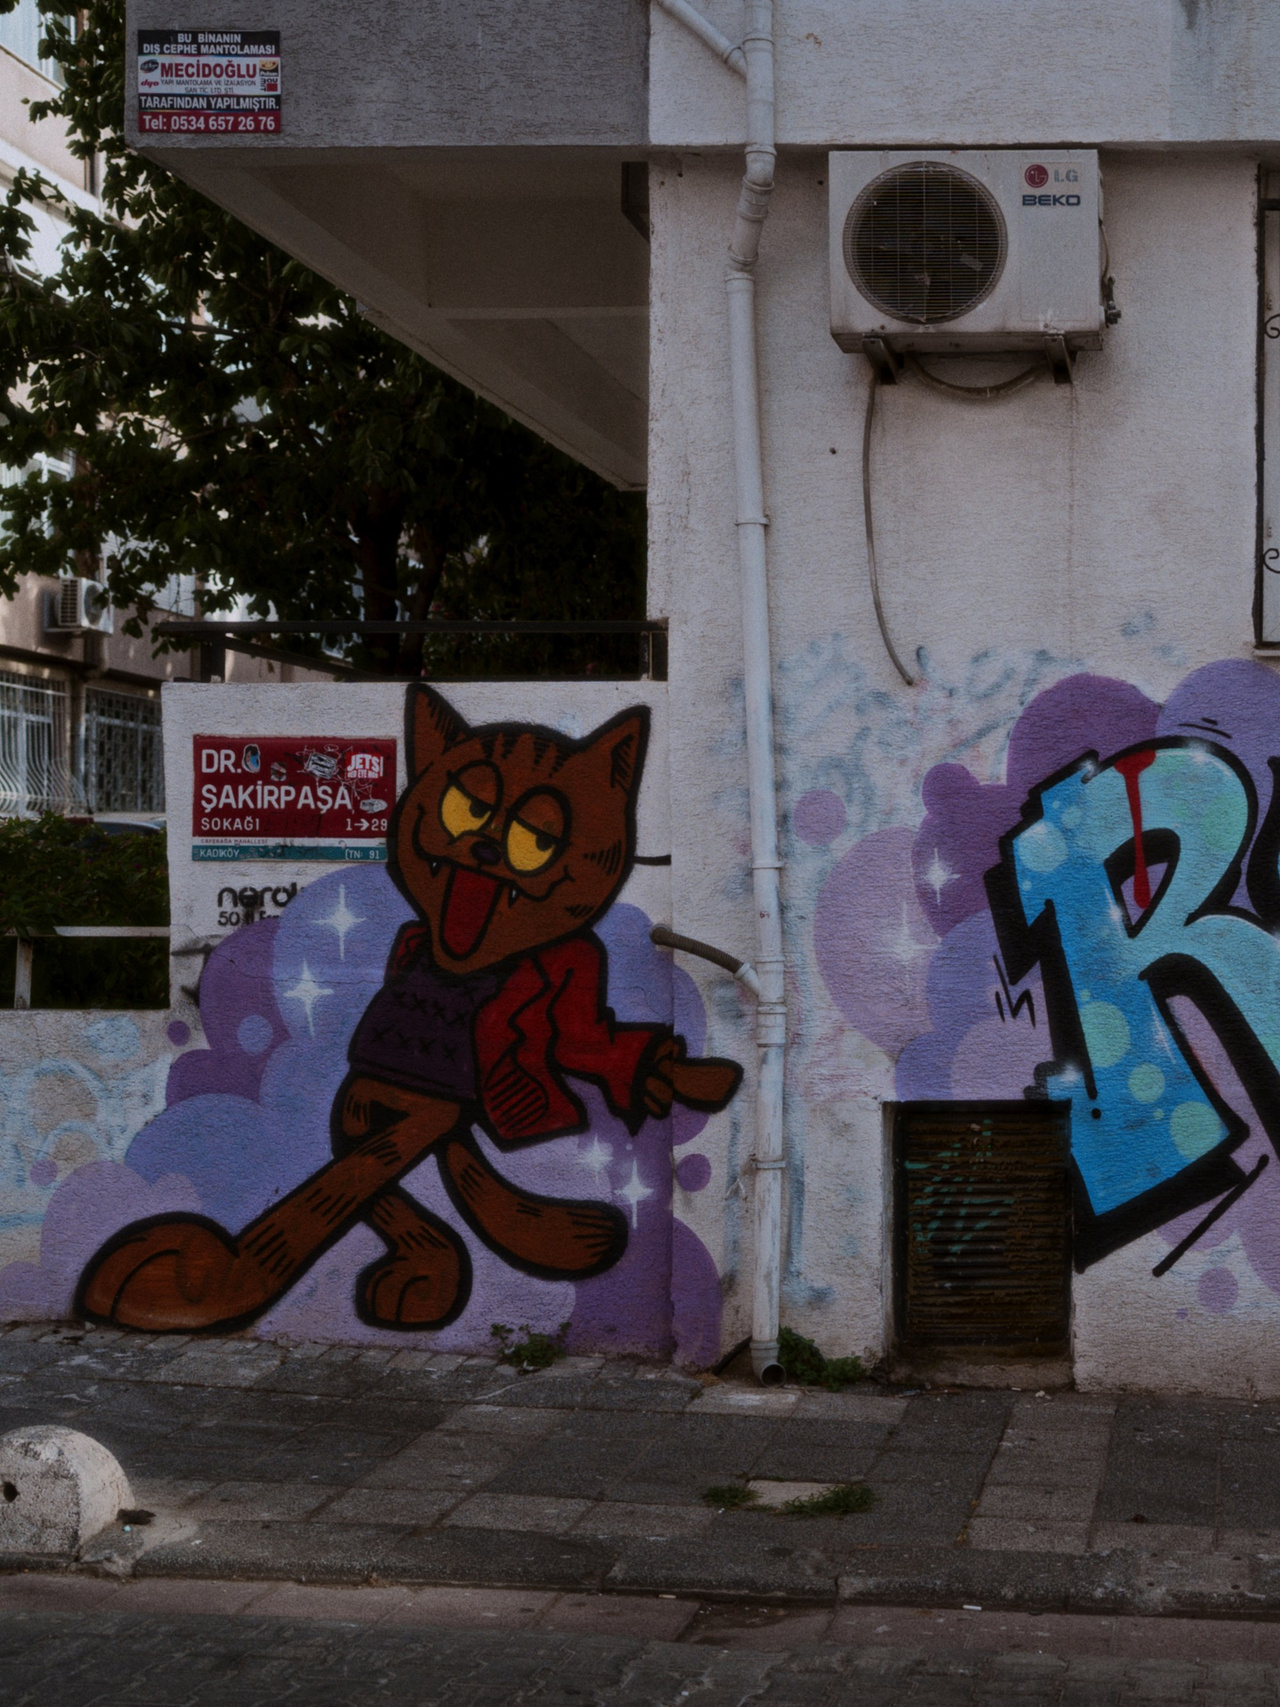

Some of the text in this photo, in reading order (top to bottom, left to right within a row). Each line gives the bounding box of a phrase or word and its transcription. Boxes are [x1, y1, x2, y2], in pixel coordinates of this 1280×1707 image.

[177, 31, 241, 43] BU BİNANIN
[143, 44, 275, 55] DIŞ CEPHE MANTOLAMASI
[160, 59, 257, 78] MECİDOĞLU
[140, 96, 280, 112] TARAFINDAN YAPILMIŞTIR.
[143, 115, 276, 131] Tel: 0534 657 26 76
[1054, 170, 1079, 183] LG
[1022, 194, 1081, 206] BEKO
[201, 749, 242, 774] DR.
[346, 753, 380, 773] JETS
[201, 780, 353, 814] ŞAKİRPAŞA
[200, 815, 388, 831] SOKAĞI 1 29
[199, 847, 240, 858] KADIKÖY
[369, 849, 381, 859] 91
